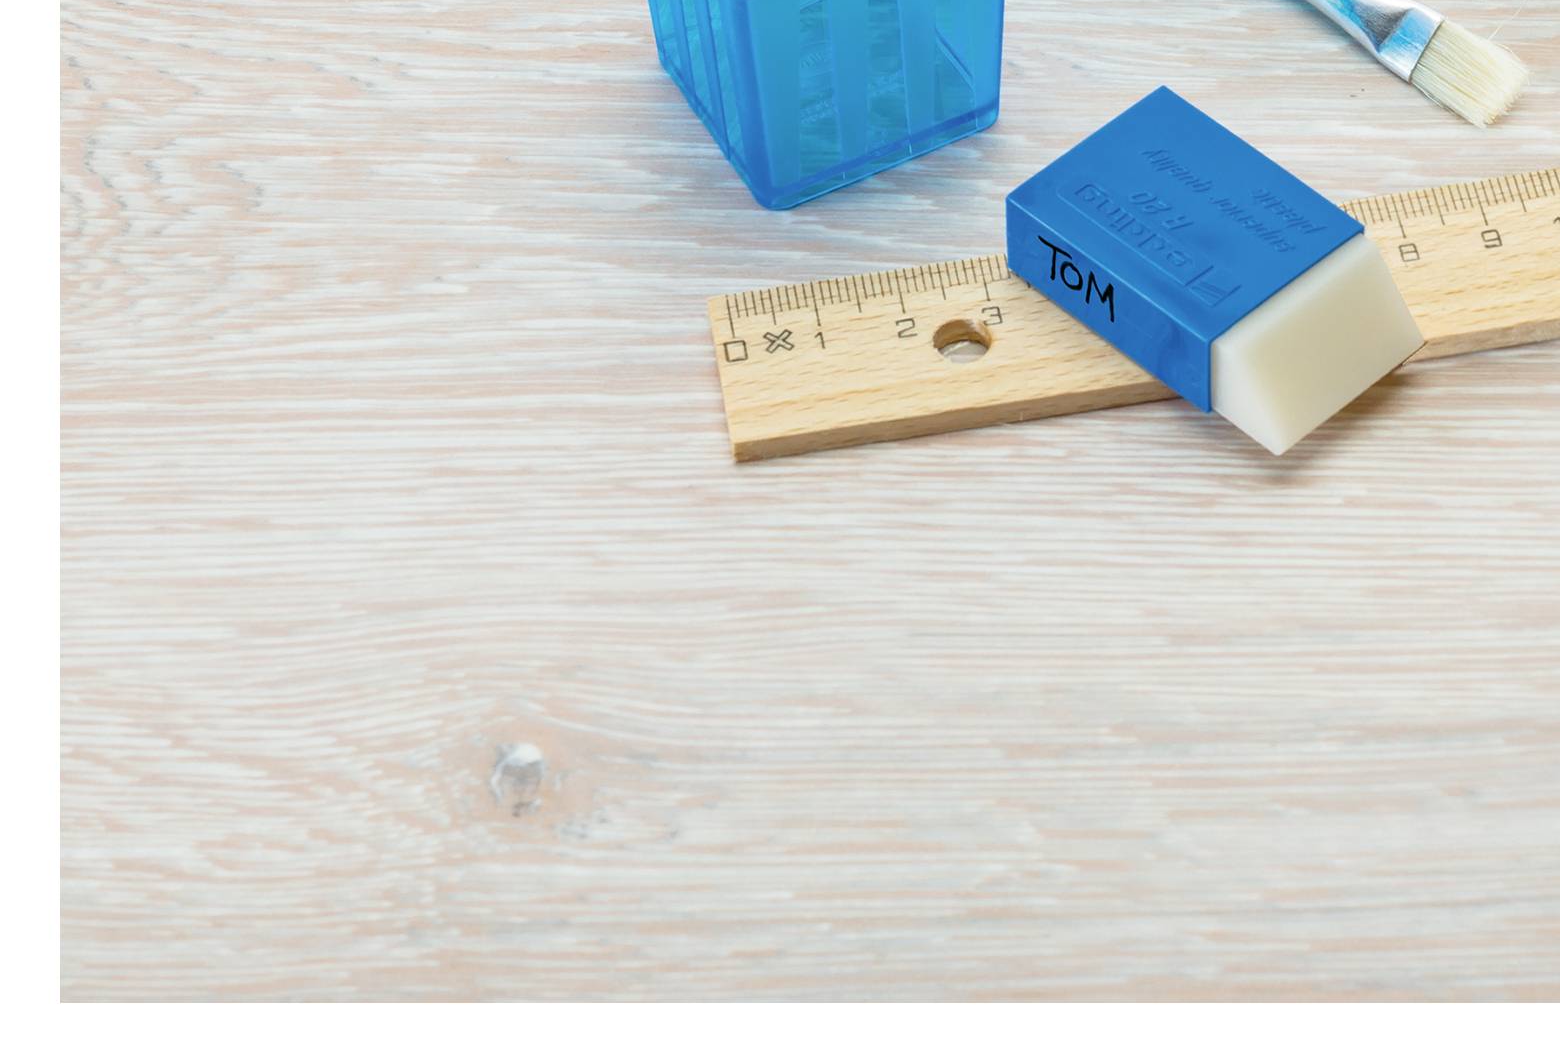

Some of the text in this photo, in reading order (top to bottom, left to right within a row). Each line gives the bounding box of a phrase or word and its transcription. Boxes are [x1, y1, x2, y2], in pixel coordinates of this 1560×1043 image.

[1073, 182, 1193, 267] edding
[1127, 191, 1194, 231] R 20
[1140, 149, 1297, 254] superior quality
[1252, 188, 1328, 235] plastic
[725, 340, 748, 362] 0
[813, 330, 827, 350] 1
[896, 317, 917, 339] 2
[981, 305, 1004, 326] 3
[1398, 242, 1420, 263] 8
[1480, 228, 1503, 249] 9
[1037, 235, 1116, 324] TOM
